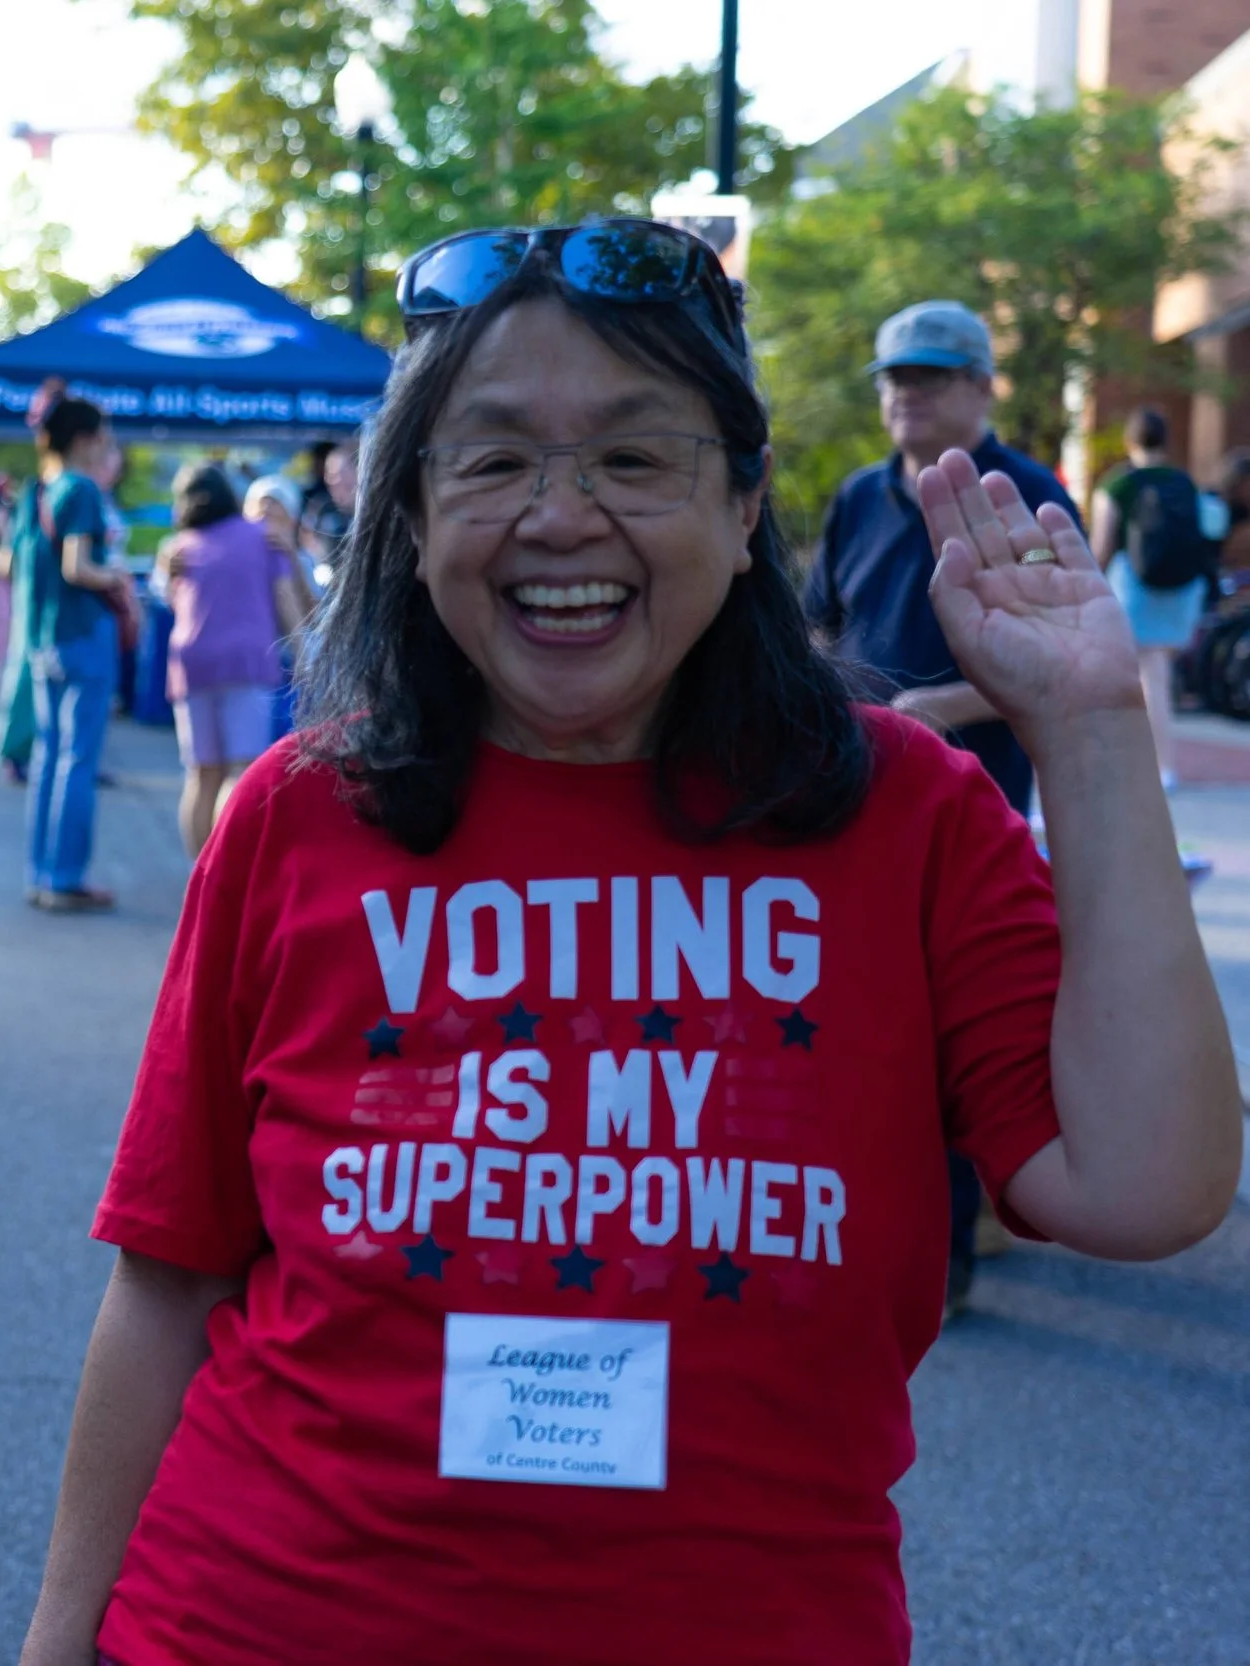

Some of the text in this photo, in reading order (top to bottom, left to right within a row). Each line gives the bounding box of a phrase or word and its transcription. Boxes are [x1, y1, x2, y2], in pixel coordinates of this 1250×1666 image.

[361, 876, 820, 1013] VOTING
[452, 1049, 719, 1149] IS MY
[322, 1142, 846, 1266] SUPERPOWER
[486, 1344, 633, 1381] League of
[502, 1377, 612, 1410] Women
[506, 1414, 602, 1446] Voters
[486, 1452, 617, 1474] of Centre County
